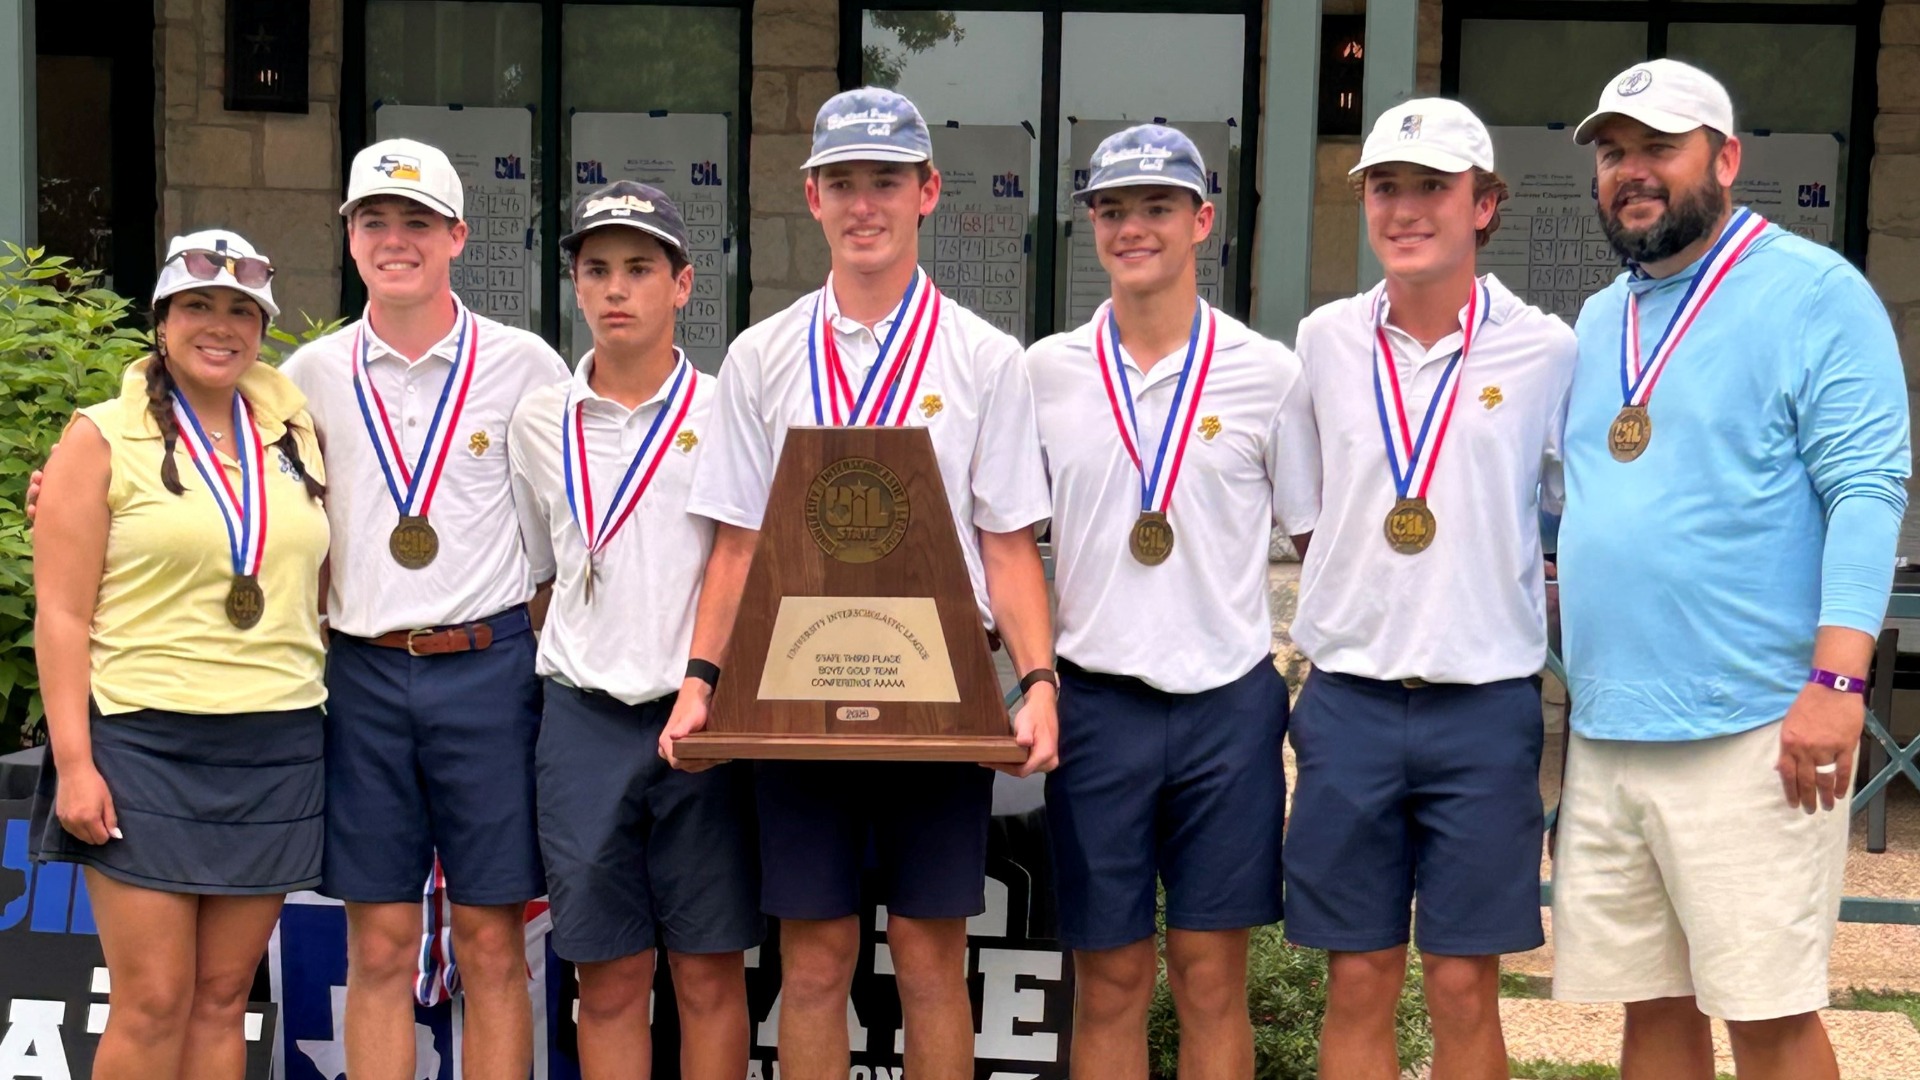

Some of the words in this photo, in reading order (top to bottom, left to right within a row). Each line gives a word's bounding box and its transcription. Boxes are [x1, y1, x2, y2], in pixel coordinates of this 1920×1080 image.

[992, 171, 1023, 198] UIL
[1797, 182, 1830, 208] UIL
[491, 197, 520, 213] 146
[963, 215, 981, 232] 68
[988, 215, 1017, 232] 142
[987, 240, 1017, 257] 150
[491, 270, 516, 286] 171
[986, 266, 1015, 282] 160
[689, 301, 715, 316] 170
[826, 480, 889, 527] UIL
[837, 528, 879, 540] STATE
